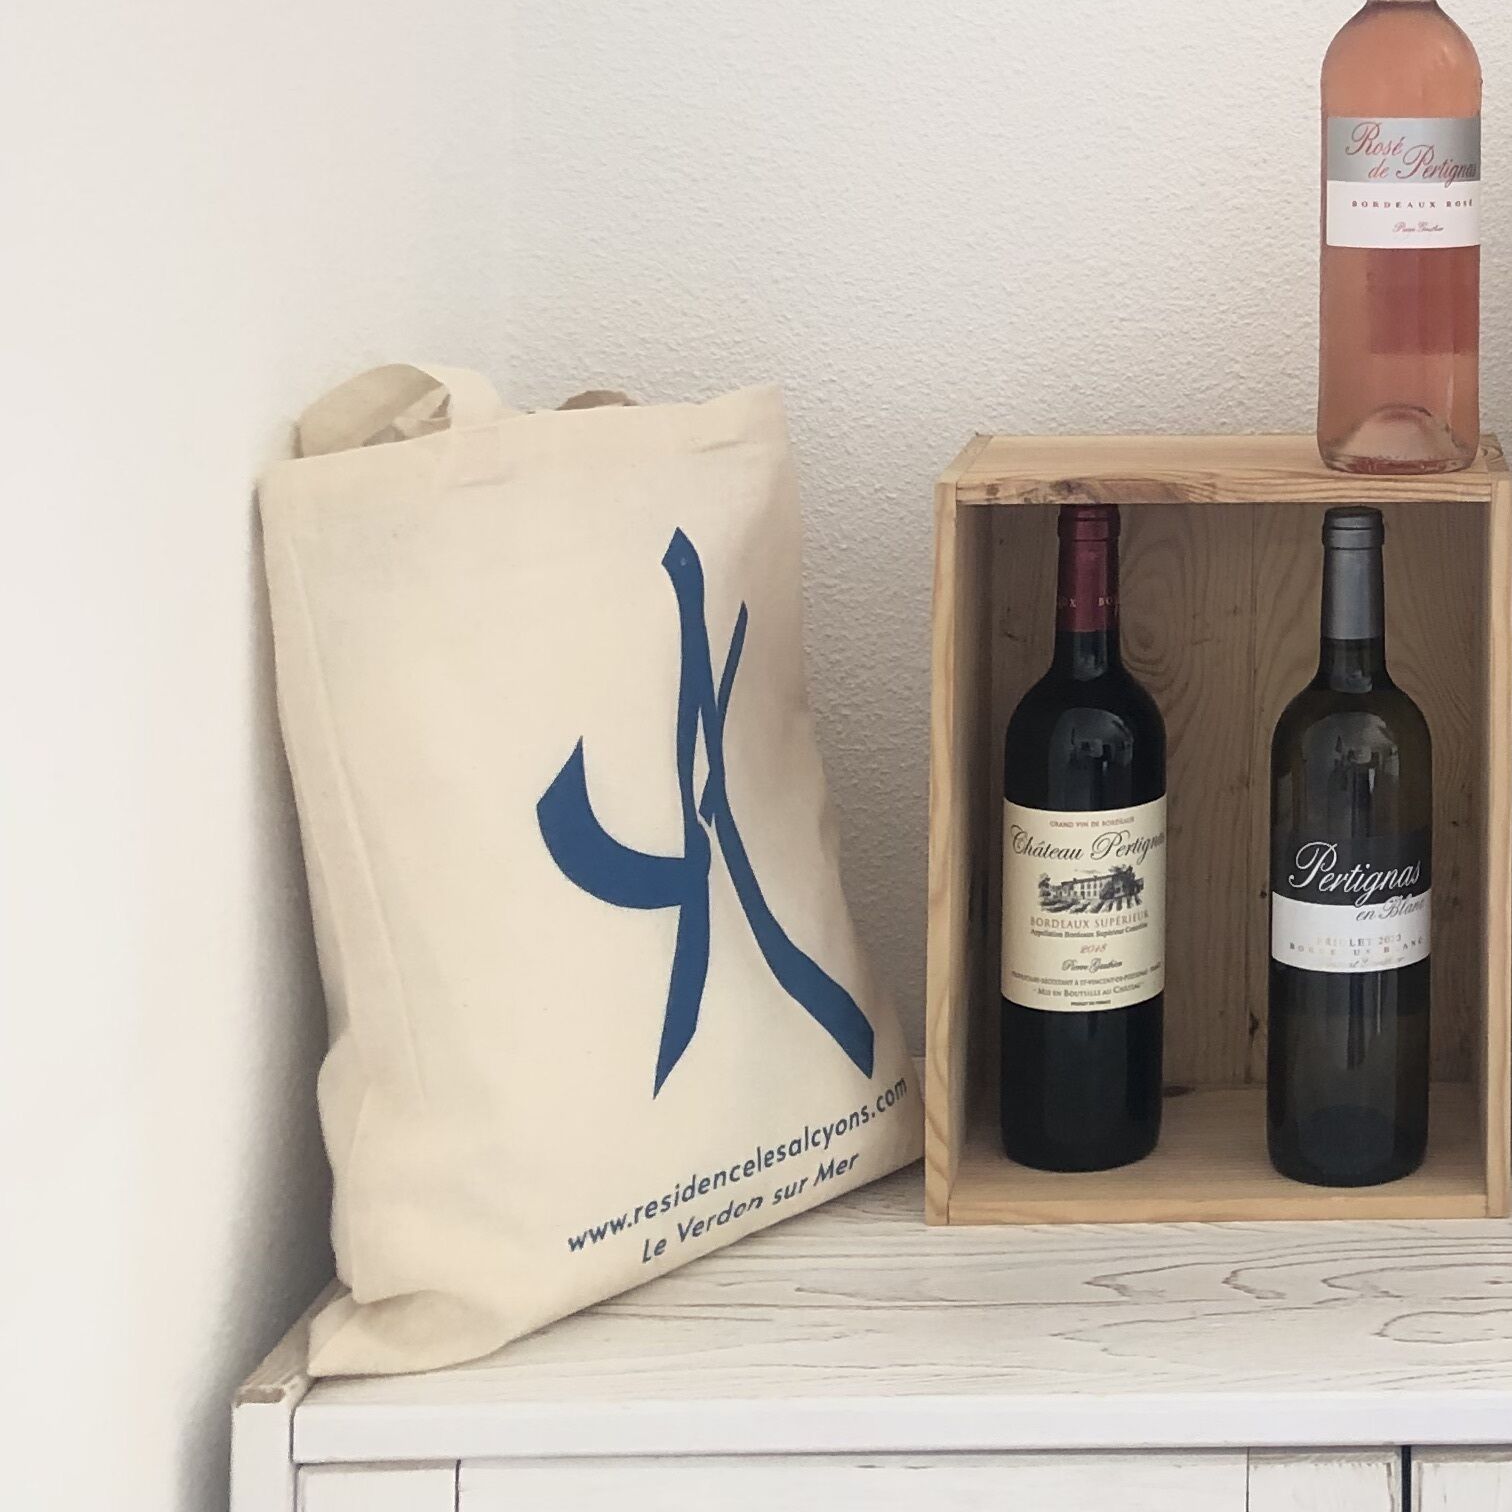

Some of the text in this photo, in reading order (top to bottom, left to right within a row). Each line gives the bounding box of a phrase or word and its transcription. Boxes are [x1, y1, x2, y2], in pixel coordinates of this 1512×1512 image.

[1345, 121, 1406, 156] Rosé
[1367, 158, 1390, 179] de
[1352, 200, 1436, 209] BORDEAUX
[1010, 824, 1084, 861] Château
[1288, 841, 1421, 908] Pertignas
[1030, 916, 1090, 929] BORDEAUX
[1356, 909, 1375, 921] en
[568, 1077, 907, 1253] www.residencelesalcyons.com
[642, 1153, 859, 1264] Le Verdon sur Mer
